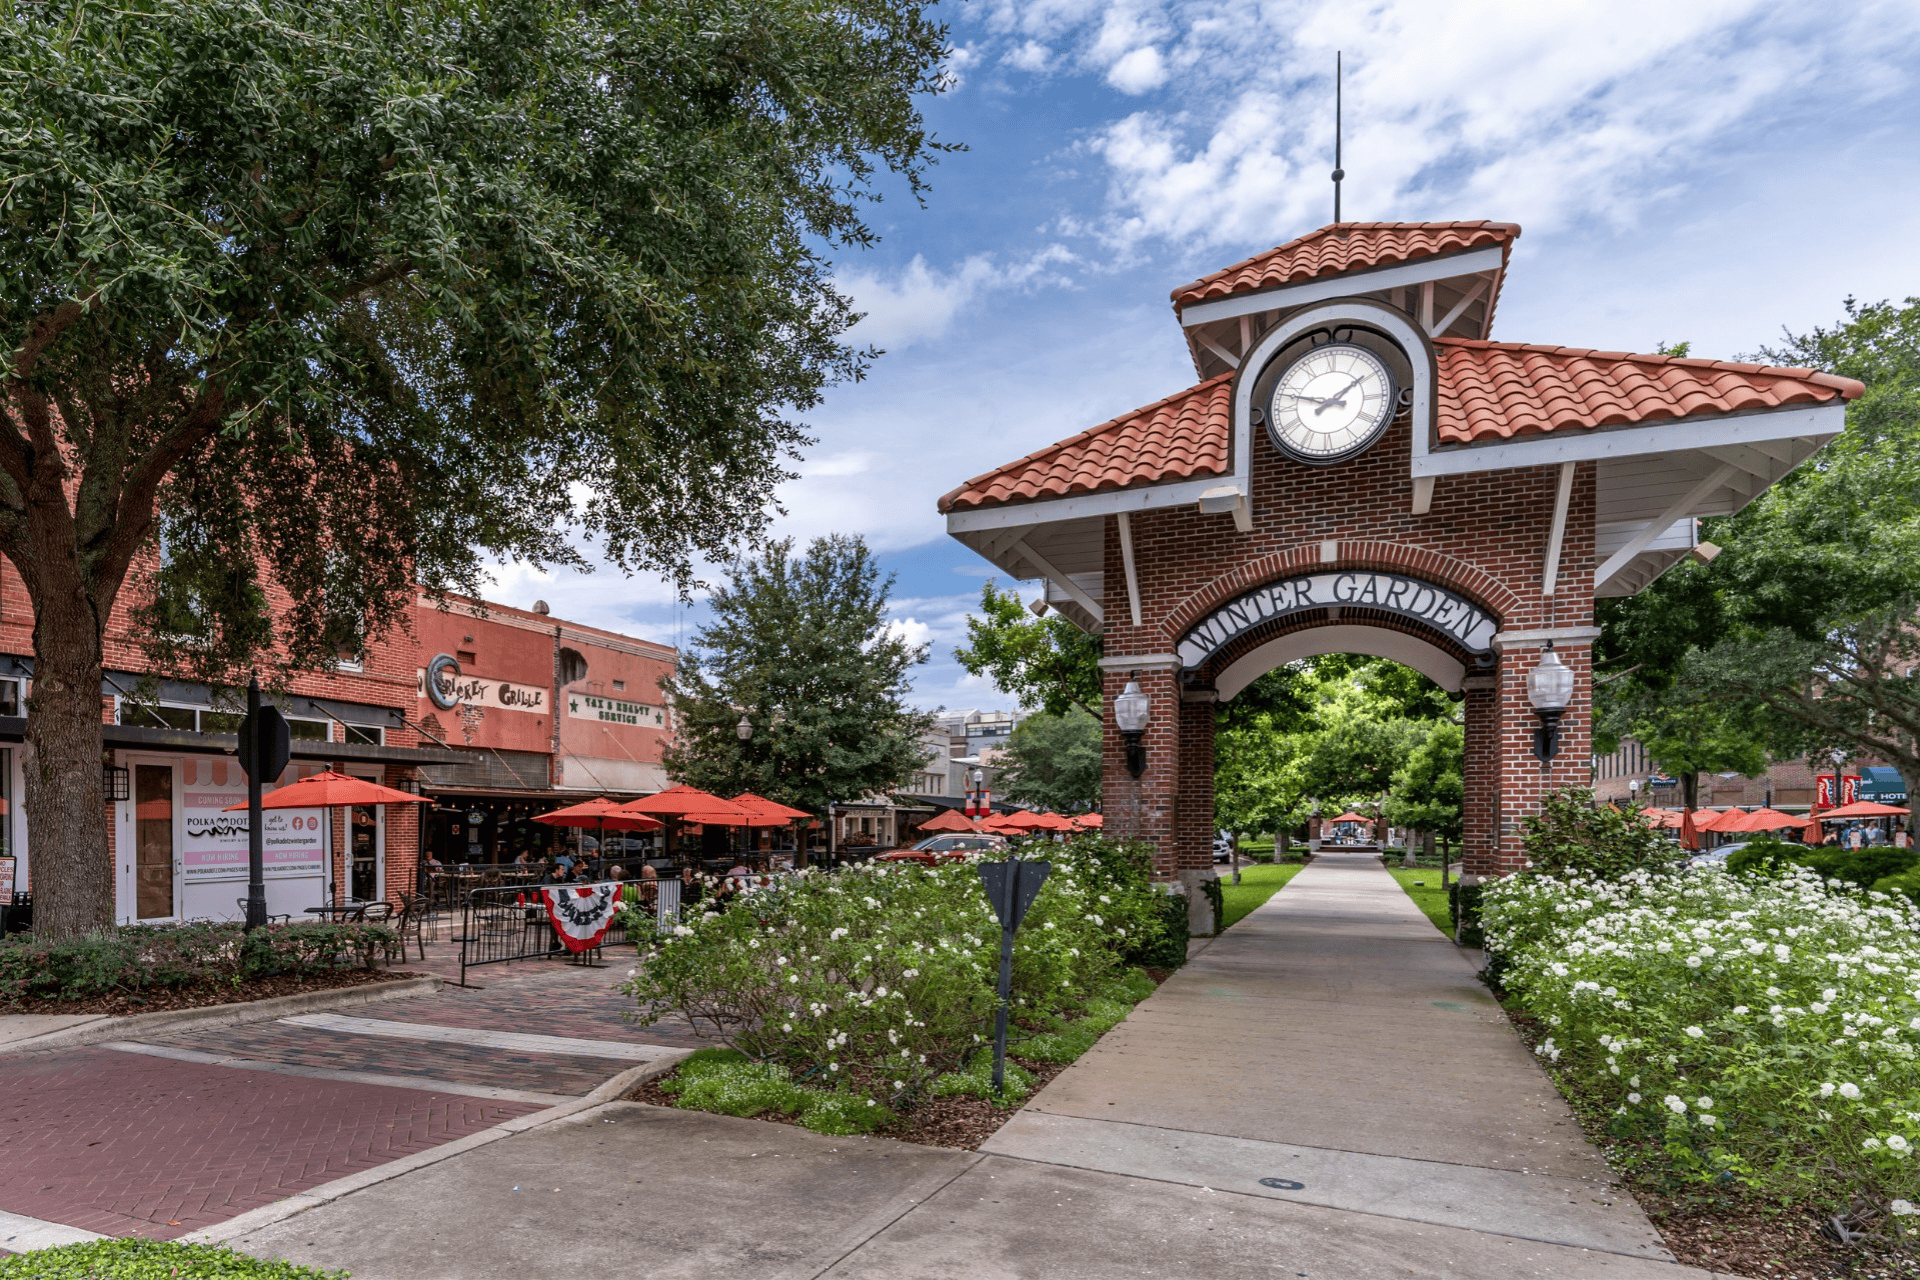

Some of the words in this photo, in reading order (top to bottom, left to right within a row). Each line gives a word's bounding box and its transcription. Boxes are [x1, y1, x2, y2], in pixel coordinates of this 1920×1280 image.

[1187, 578, 1316, 655] WINTER
[1333, 573, 1487, 641] GARDEN
[498, 683, 543, 708] GRILLE
[585, 697, 604, 709] TAX
[616, 702, 650, 716] REALTY
[599, 711, 637, 724] SERVICE
[198, 796, 224, 805] COMING
[187, 817, 215, 826] POLKA
[230, 817, 250, 826] DOT
